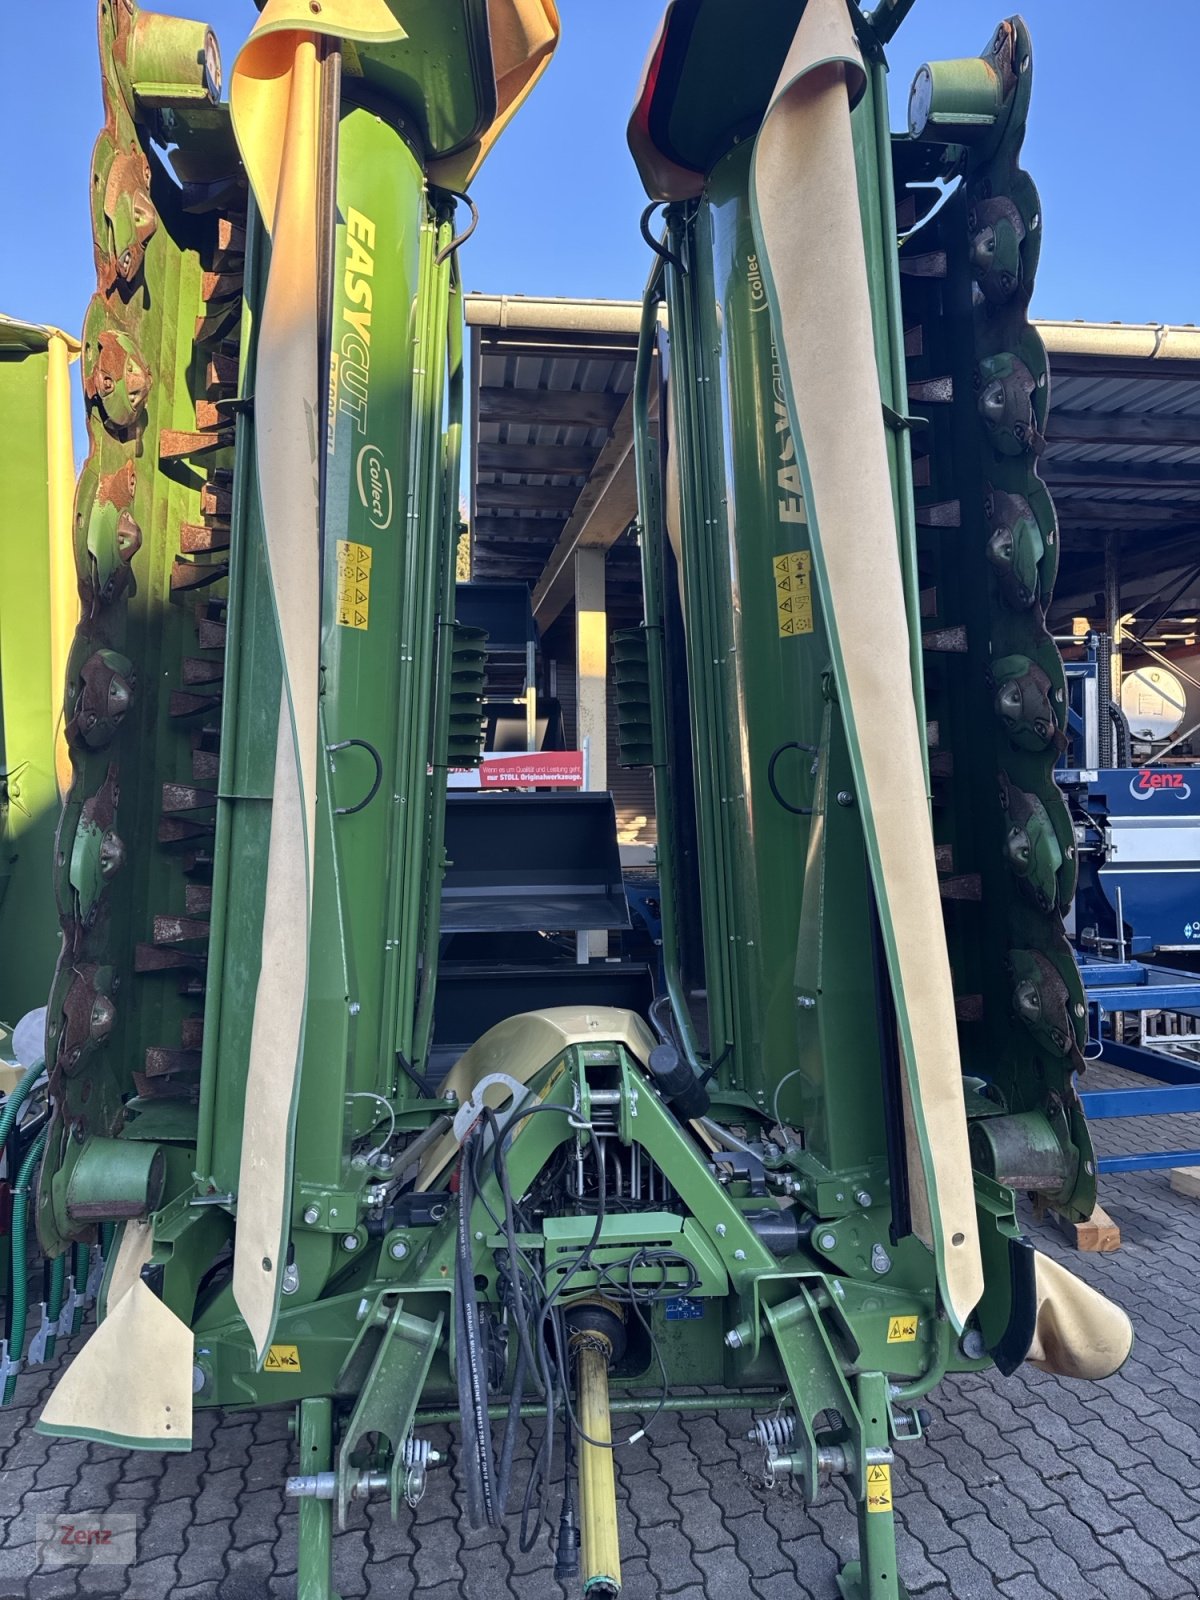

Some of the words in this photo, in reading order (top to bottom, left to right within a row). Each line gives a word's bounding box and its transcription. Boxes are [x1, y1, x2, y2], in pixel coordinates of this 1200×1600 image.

[339, 206, 376, 435] EASYCUT
[369, 457, 384, 517] Collect
[1139, 770, 1183, 787] Zenz
